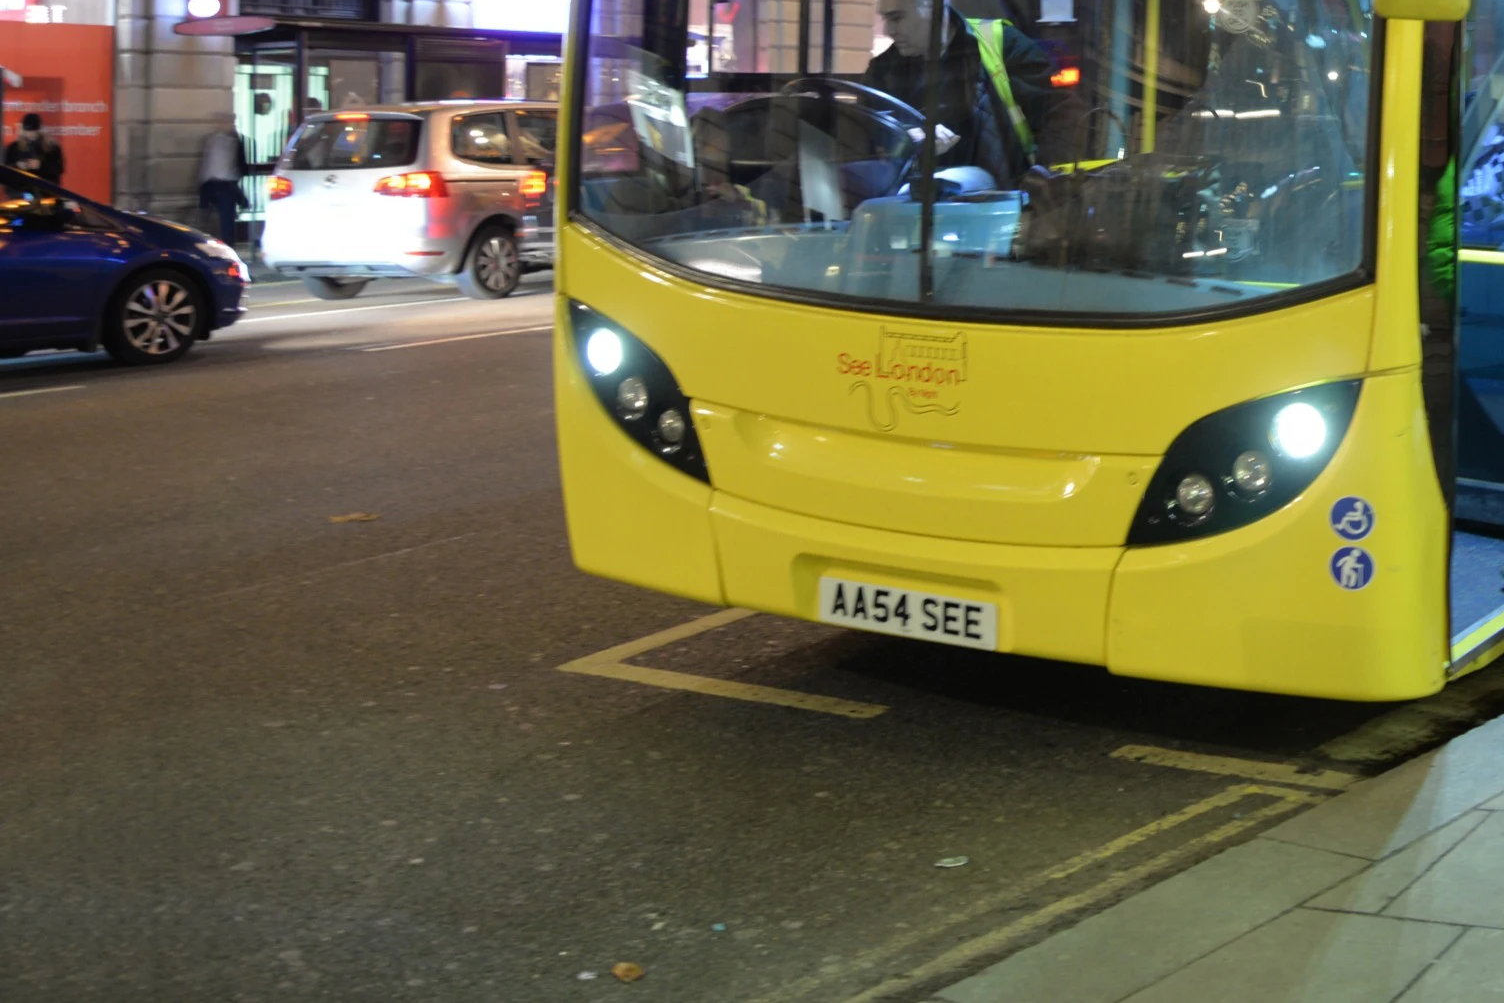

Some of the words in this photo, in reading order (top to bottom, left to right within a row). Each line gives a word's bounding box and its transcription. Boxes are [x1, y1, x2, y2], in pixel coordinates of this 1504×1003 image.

[836, 352, 872, 377] See
[874, 352, 961, 386] London
[832, 582, 911, 627] AA54
[921, 598, 982, 640] SEE
